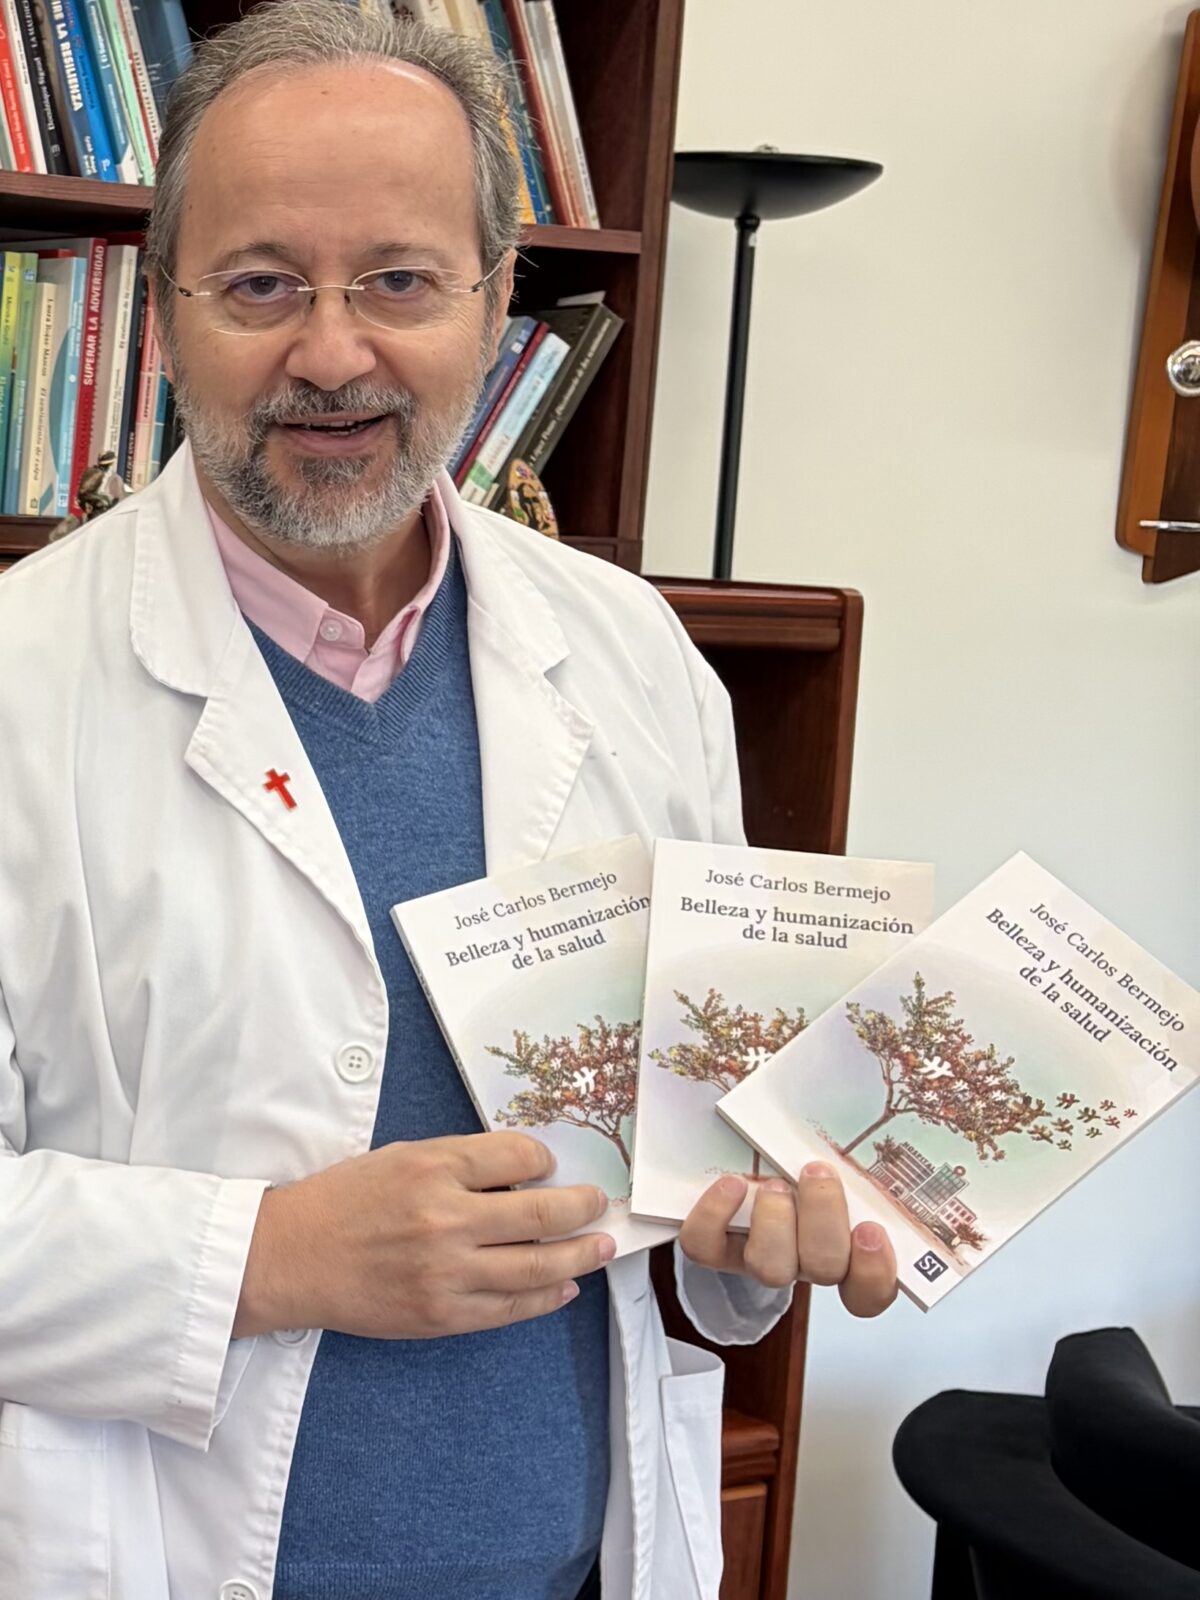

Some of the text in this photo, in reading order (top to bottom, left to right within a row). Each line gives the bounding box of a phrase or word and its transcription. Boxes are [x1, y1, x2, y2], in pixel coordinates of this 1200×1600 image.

[56, 23, 69, 39] LA
[60, 42, 84, 112] RESILIENZA
[83, 245, 105, 386] SUPERAR LA ADVERSIDAD
[454, 871, 618, 931] José Carlos Bermejo
[680, 896, 915, 935] Belleza y humanización
[705, 869, 892, 904] José Carlos Bermejo
[445, 895, 650, 968] Belleza y humanización
[511, 929, 607, 971] de la salud
[742, 924, 849, 949] de la salud
[985, 907, 1179, 1072] Belleza y humanización
[1029, 903, 1185, 1032] José Carlos Bermejo
[1019, 965, 1112, 1043] de la salud
[902, 1141, 936, 1173] HOSPITAL
